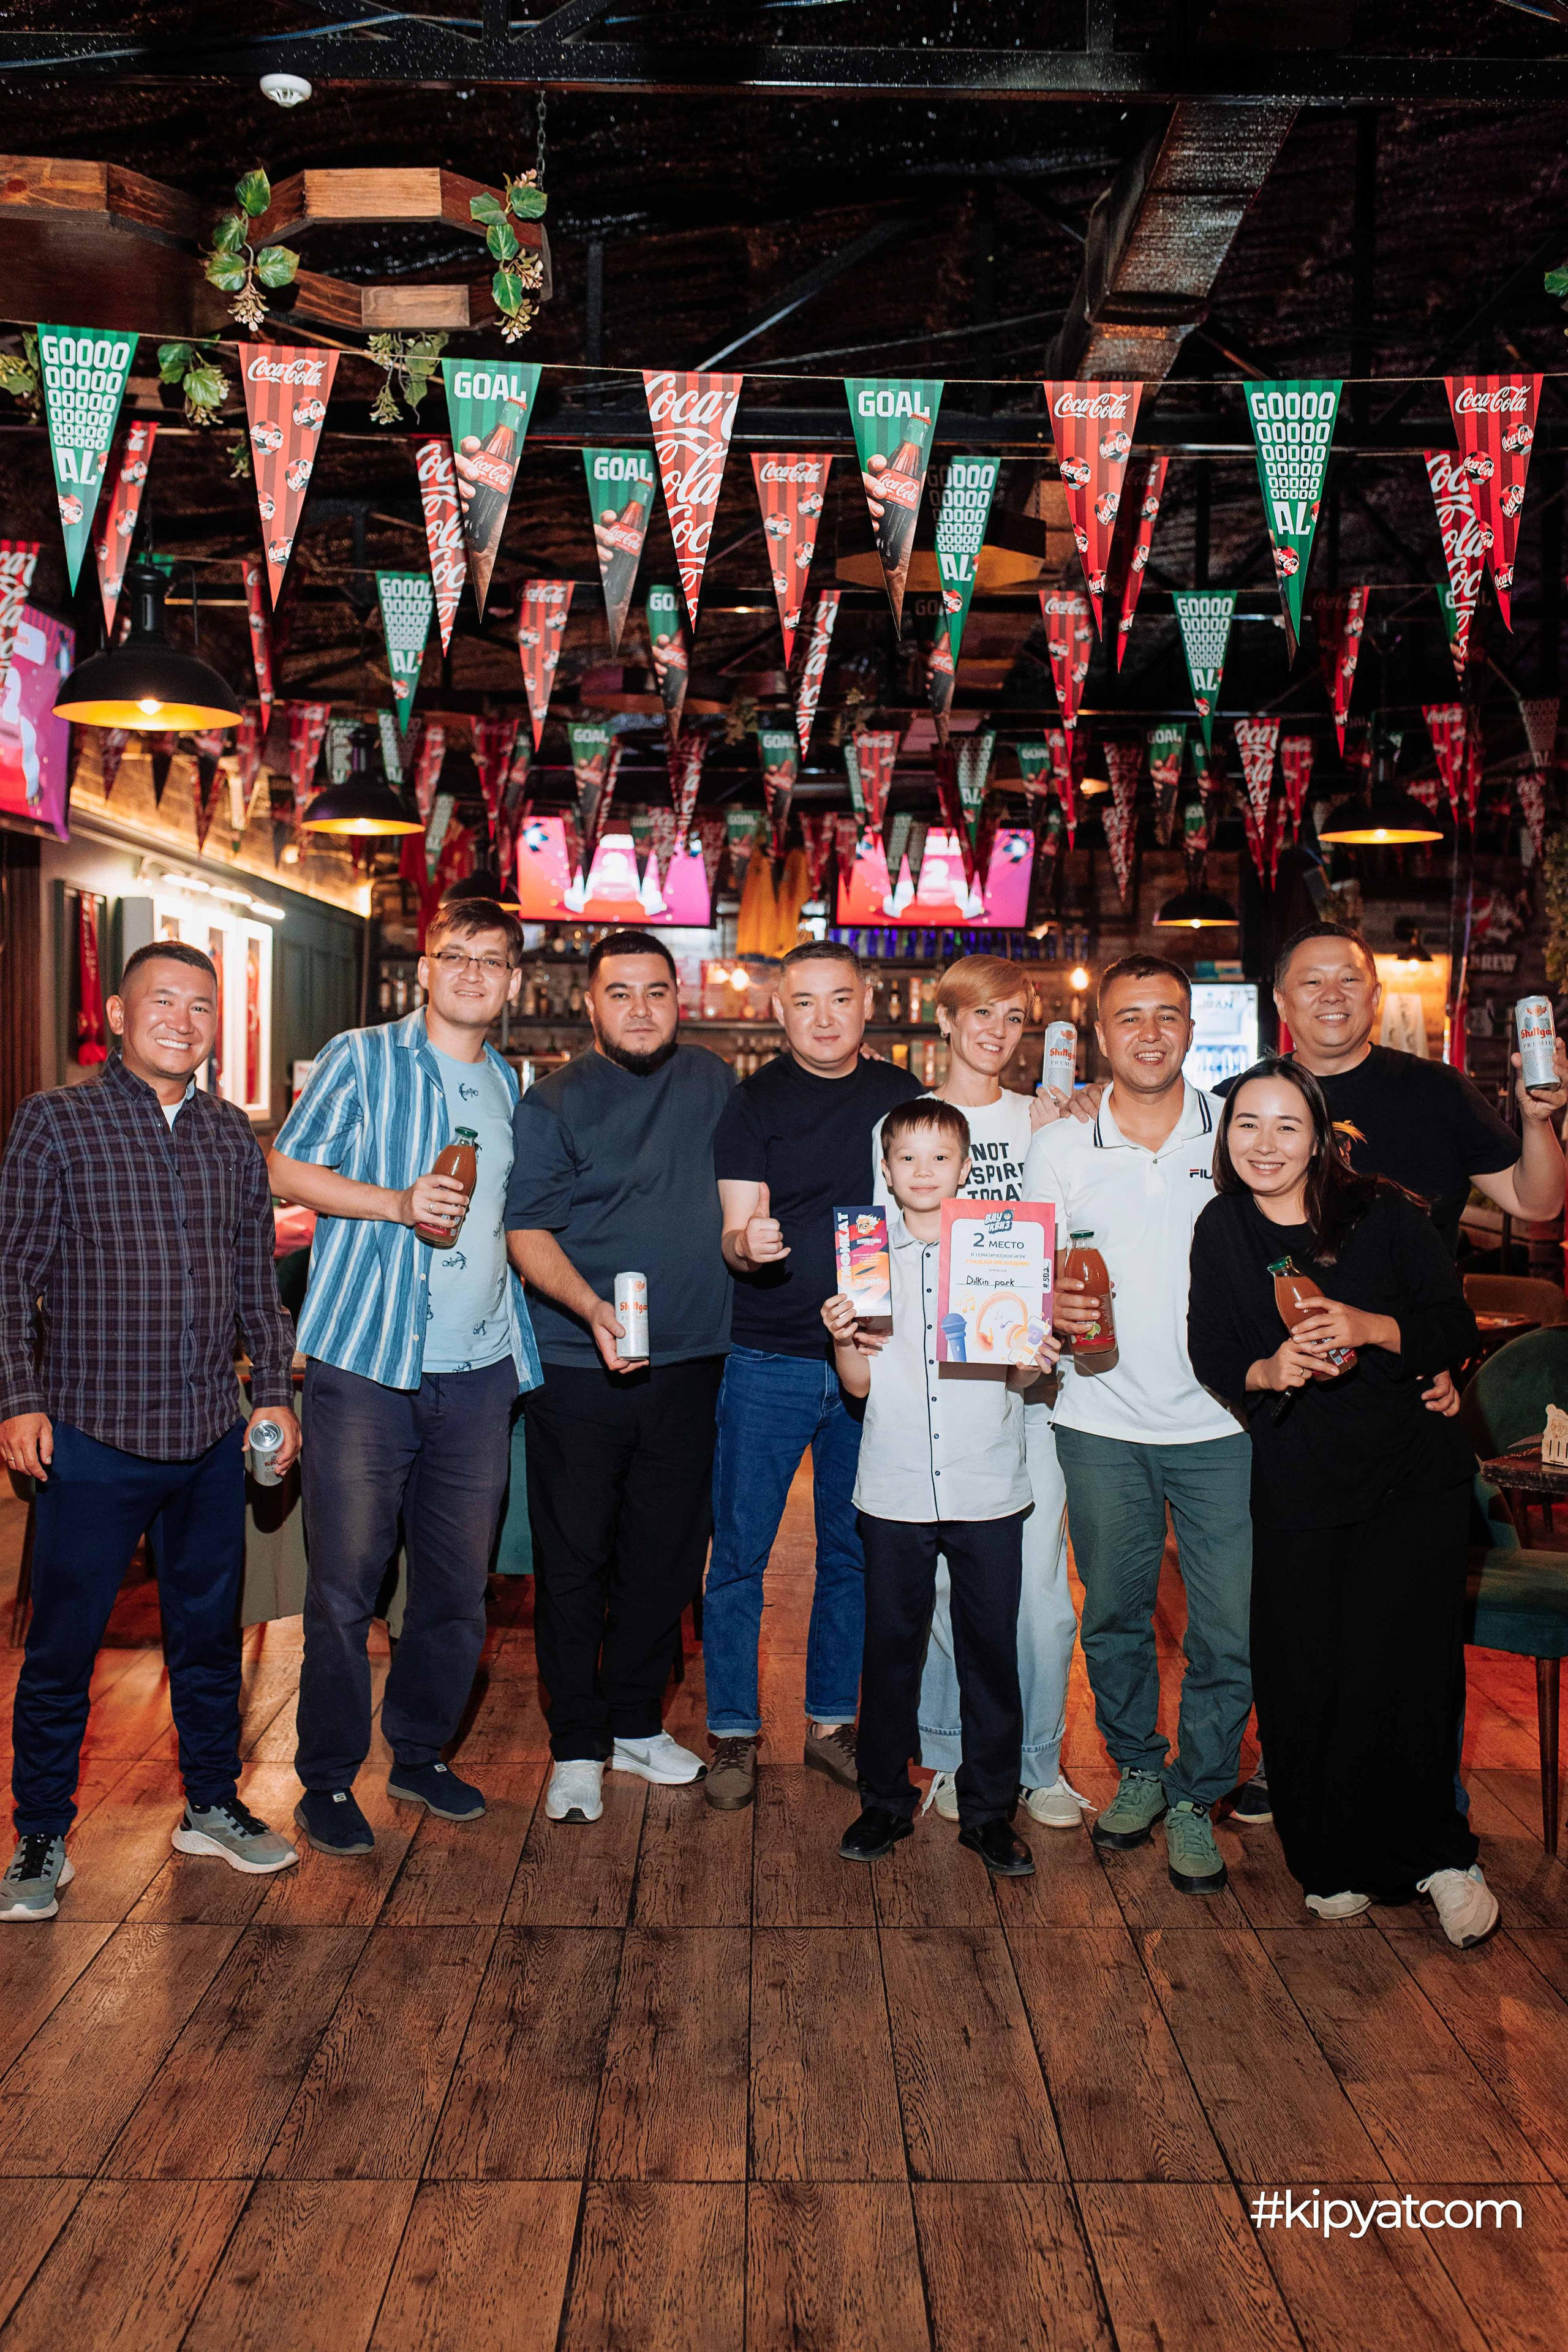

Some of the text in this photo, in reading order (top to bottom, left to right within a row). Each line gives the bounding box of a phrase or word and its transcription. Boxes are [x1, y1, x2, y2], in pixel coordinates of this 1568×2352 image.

[42, 335, 130, 371] GOOOO
[46, 366, 123, 394] OOOOO
[247, 355, 326, 386] Coca-Cola
[454, 371, 526, 402] GOAL
[48, 390, 118, 412] OOOOO
[859, 390, 930, 418] GOAL
[1054, 393, 1131, 420] Coca-Cola
[1250, 392, 1336, 420] GOOOO
[1455, 385, 1532, 414] Coca-Cola
[50, 407, 113, 427] OOOOO
[52, 422, 109, 439] OOOOO
[1256, 422, 1330, 444] OOOOO
[54, 435, 107, 450] OOOOO
[1261, 444, 1327, 462] OOOOO
[56, 447, 97, 485] AL
[594, 457, 653, 482] GOAL
[760, 461, 823, 484] Coca-Cola
[1265, 462, 1323, 477] OOOOO
[1268, 477, 1320, 489] OOOOO
[1270, 489, 1317, 500] OOOOO
[1272, 501, 1312, 536] AL
[939, 554, 973, 582] AL
[1177, 597, 1234, 616] GOOOO
[391, 651, 420, 674] AL
[1191, 669, 1216, 692] AL
[971, 1142, 1009, 1161] NOT
[966, 1162, 1025, 1185] SPIR
[1189, 1169, 1213, 1180] FIL
[984, 1212, 1003, 1226] ВАУ
[989, 1220, 1012, 1234] КВИЗ
[973, 1232, 1024, 1250] 2 МЕСТО
